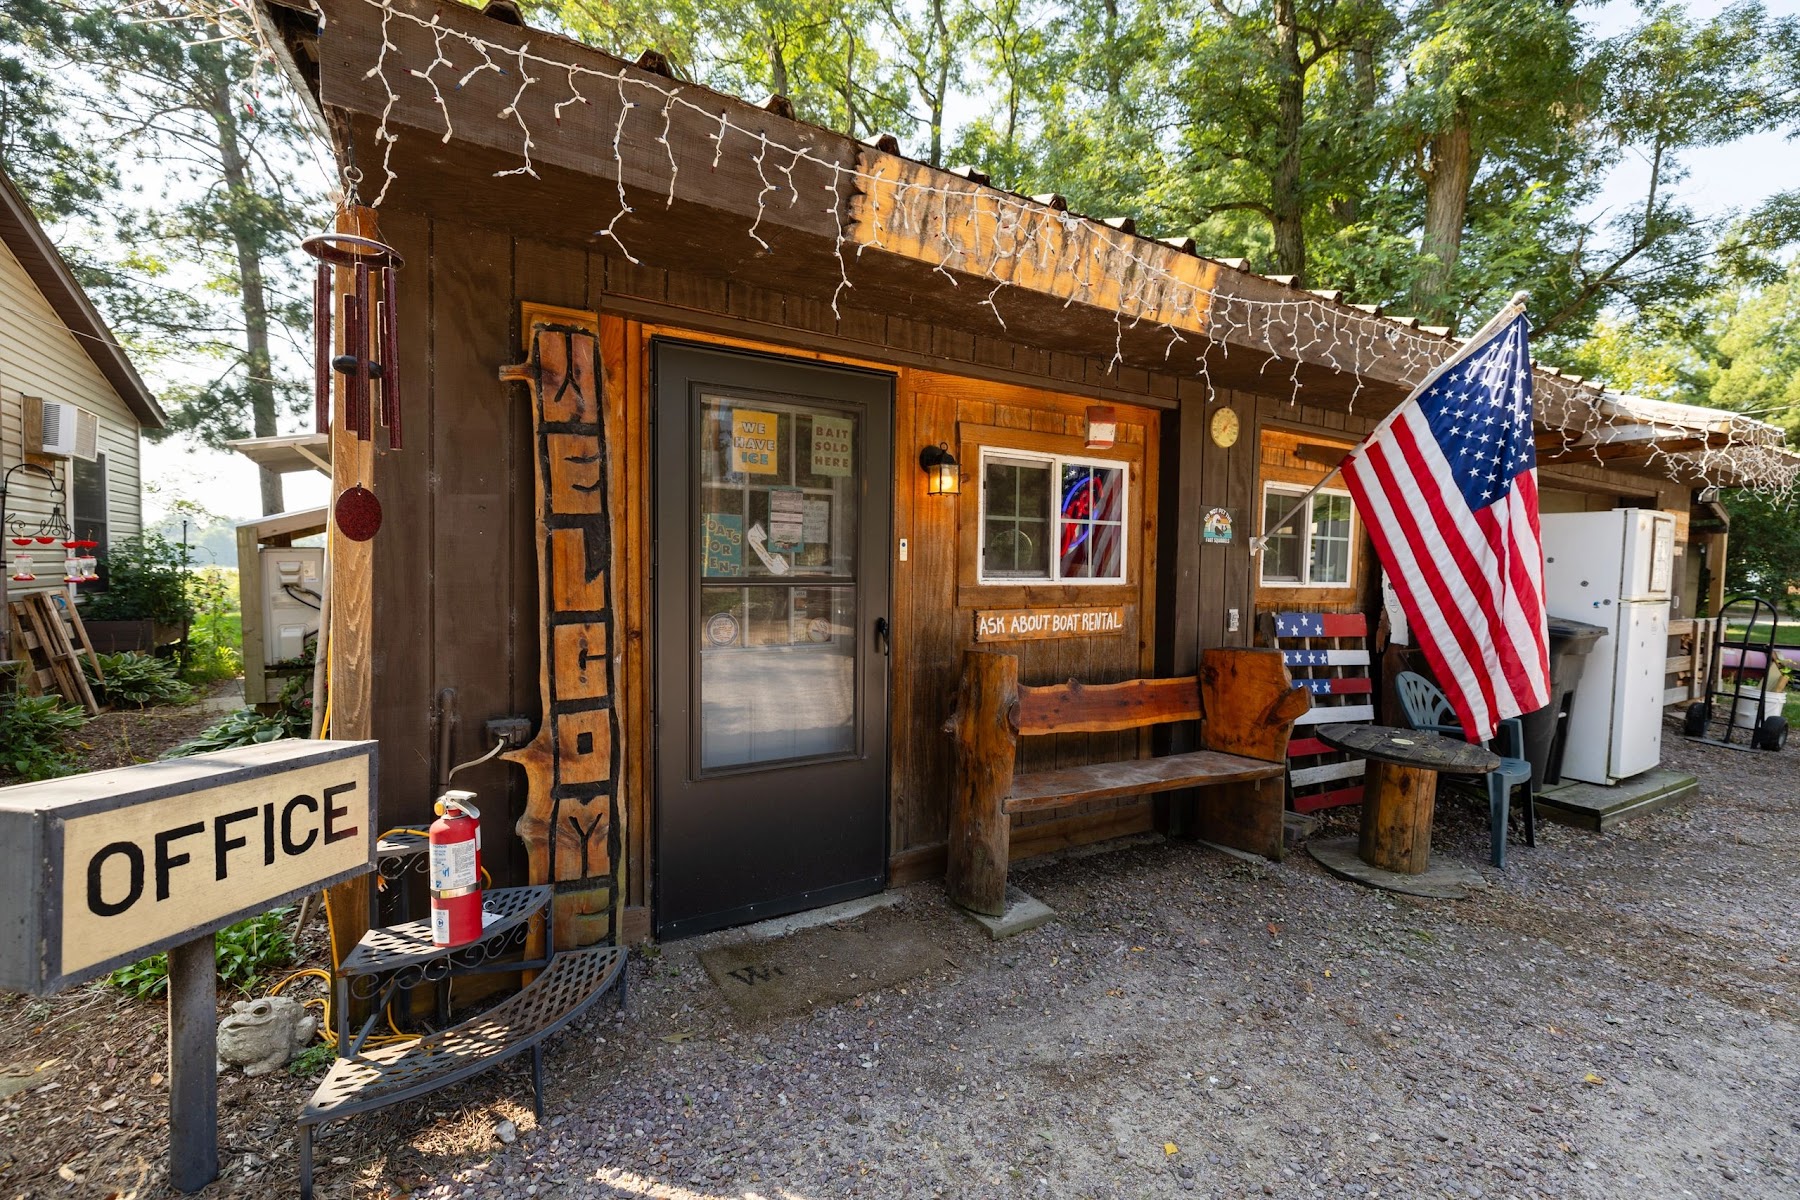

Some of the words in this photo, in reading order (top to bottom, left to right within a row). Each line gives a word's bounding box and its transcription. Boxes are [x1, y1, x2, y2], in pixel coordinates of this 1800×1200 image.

[741, 422, 765, 434] WE
[815, 426, 849, 439] BAIT
[734, 437, 775, 451] HAVE
[815, 441, 849, 453] SOLD
[741, 452, 769, 465] ICE
[815, 456, 849, 468] HERE
[979, 617, 1005, 635] ASK
[1010, 615, 1051, 633] ABOUT
[1052, 613, 1081, 631] BOAT
[1082, 612, 1122, 631] RENTAL
[87, 781, 358, 917] OFFICE
